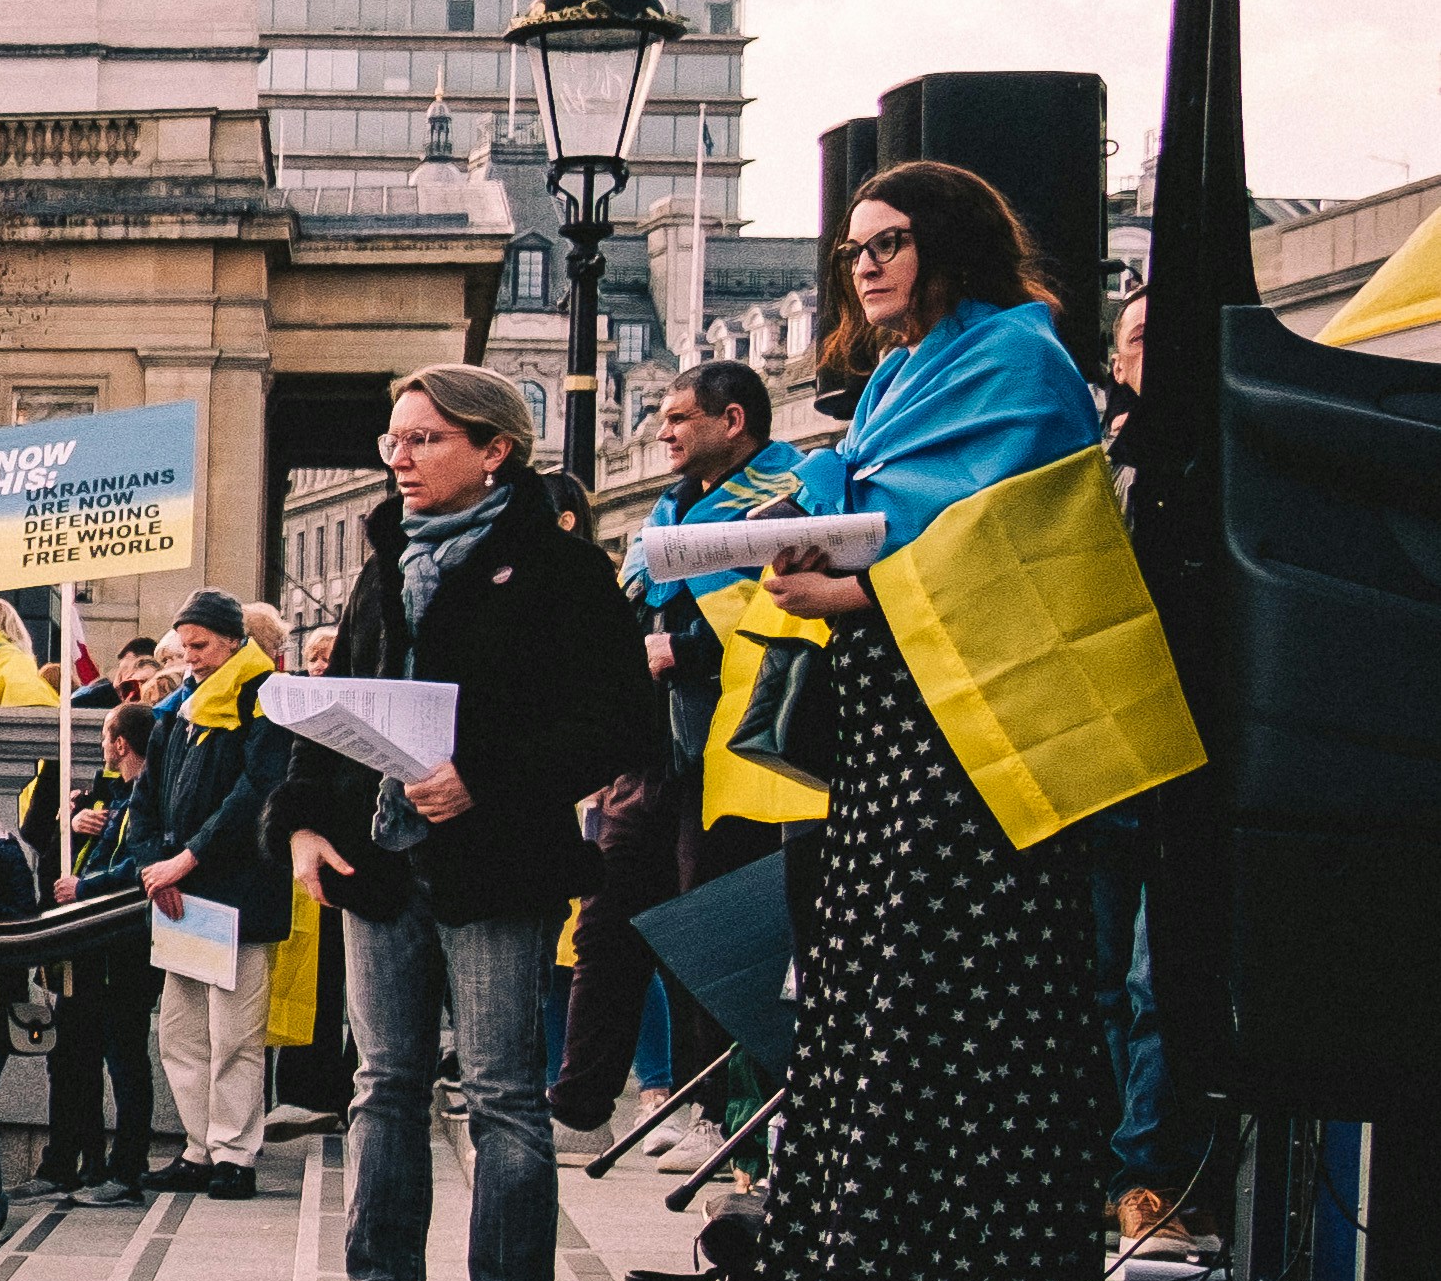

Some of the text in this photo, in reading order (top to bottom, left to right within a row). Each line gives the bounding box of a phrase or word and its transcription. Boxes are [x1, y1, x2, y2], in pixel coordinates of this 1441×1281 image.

[26, 469, 175, 502] UKRAINIANS
[24, 504, 160, 534] DEFENDING
[25, 490, 134, 519] ARE NOW
[24, 520, 162, 550] THE WHOLE
[22, 536, 174, 568] FREE WORLD
